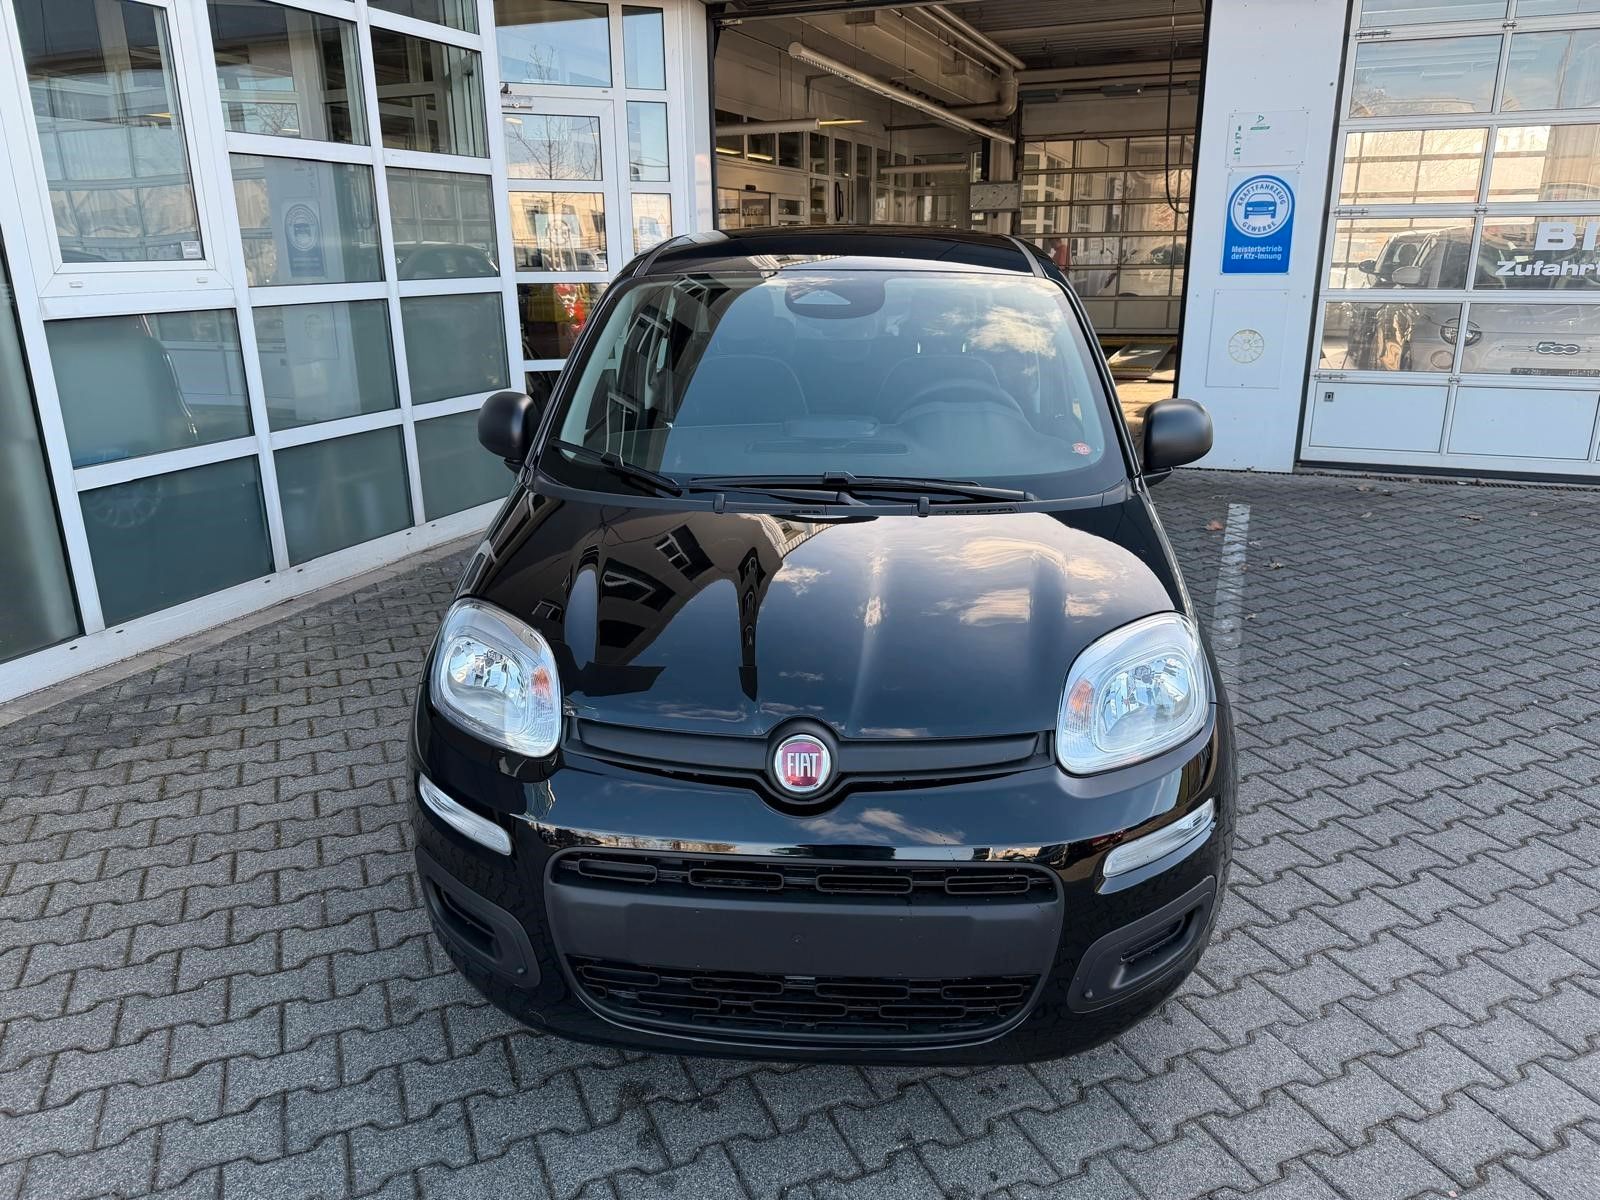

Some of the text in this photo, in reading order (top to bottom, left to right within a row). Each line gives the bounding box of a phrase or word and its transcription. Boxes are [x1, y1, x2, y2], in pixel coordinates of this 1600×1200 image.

[1237, 184, 1287, 206] KRAFTFAHRZEUG
[1242, 221, 1277, 232] GEWERBE
[1231, 245, 1282, 253] Meisterbetrieb
[1243, 253, 1282, 261] Kfz-Innung
[787, 752, 819, 777] FIAT
